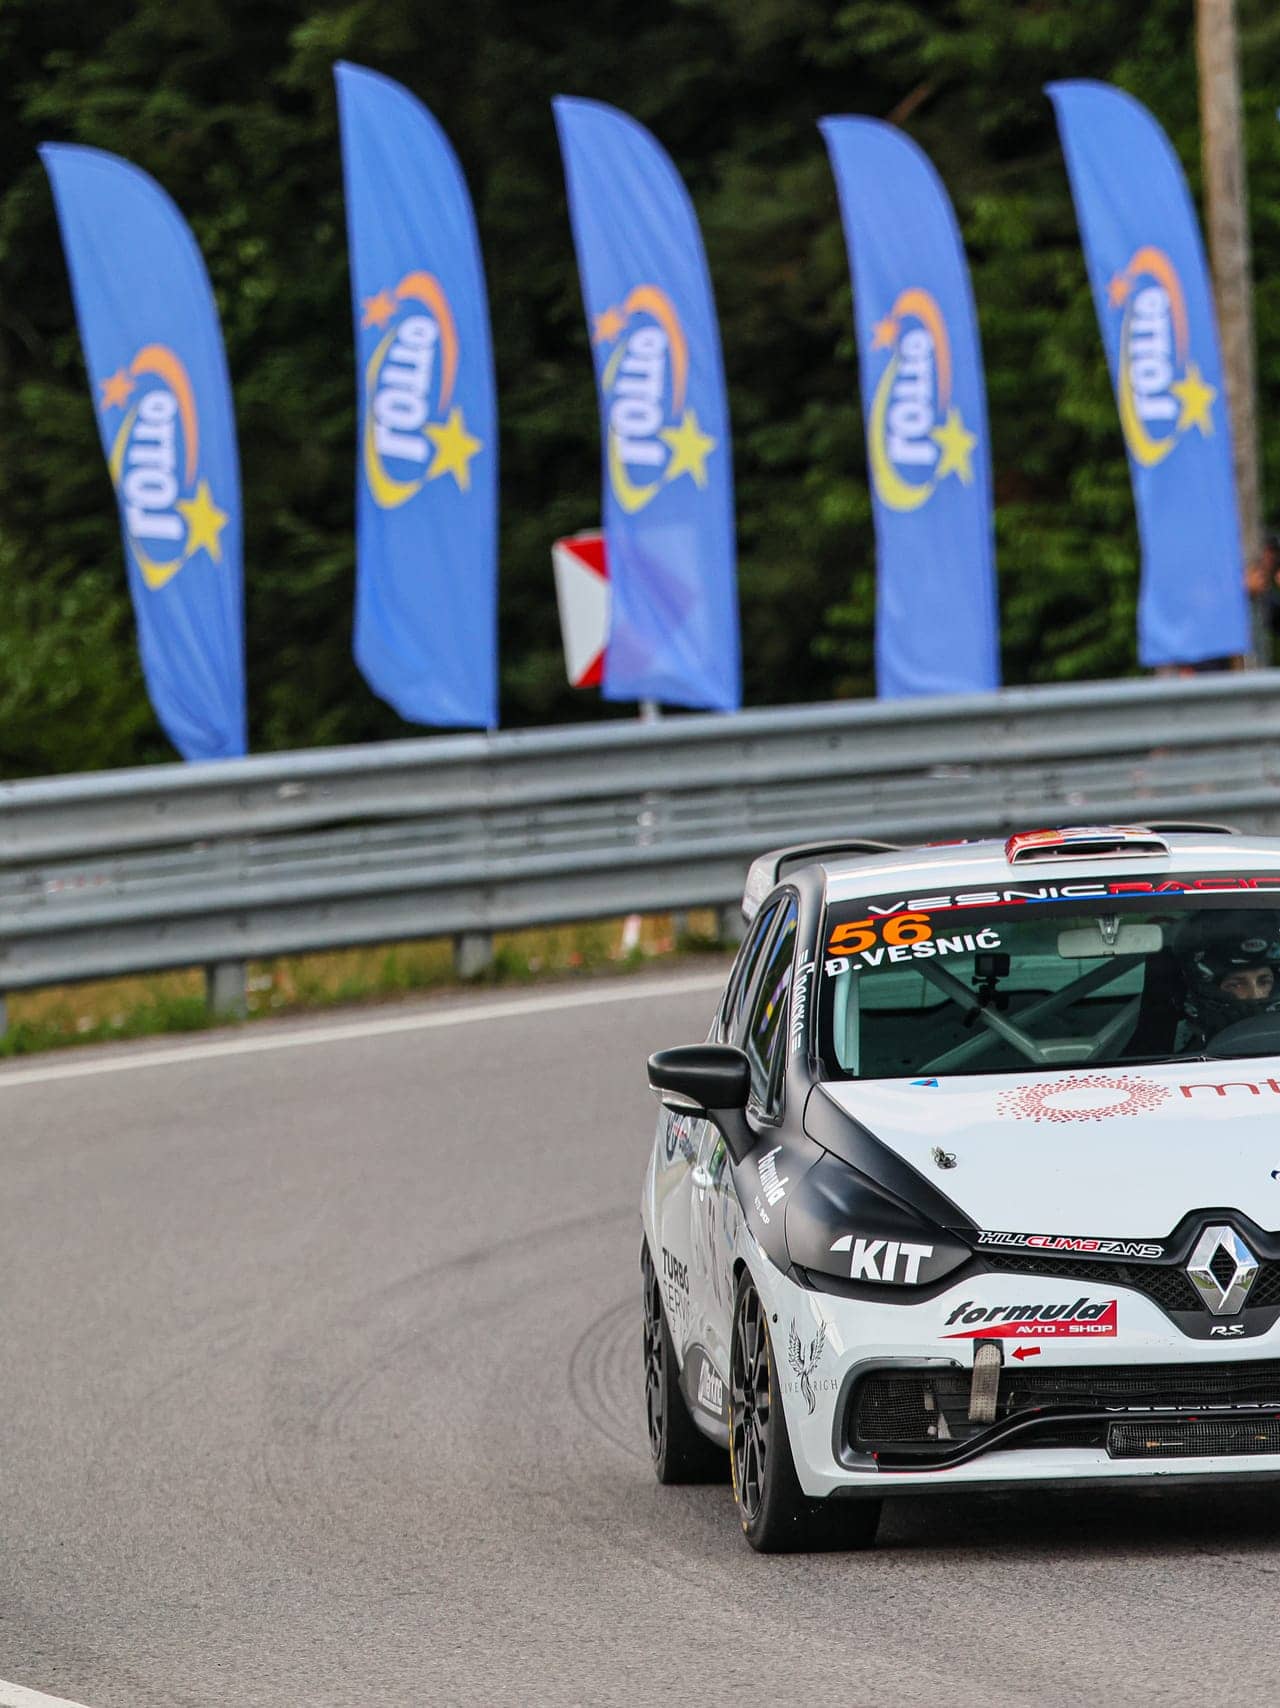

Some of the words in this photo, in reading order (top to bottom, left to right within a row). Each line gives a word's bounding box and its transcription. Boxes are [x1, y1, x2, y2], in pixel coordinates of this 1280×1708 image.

[827, 914, 932, 956] 56
[850, 1239, 934, 1284] KIT
[944, 1298, 1109, 1326] formula
[1069, 1324, 1113, 1333] SHOP
